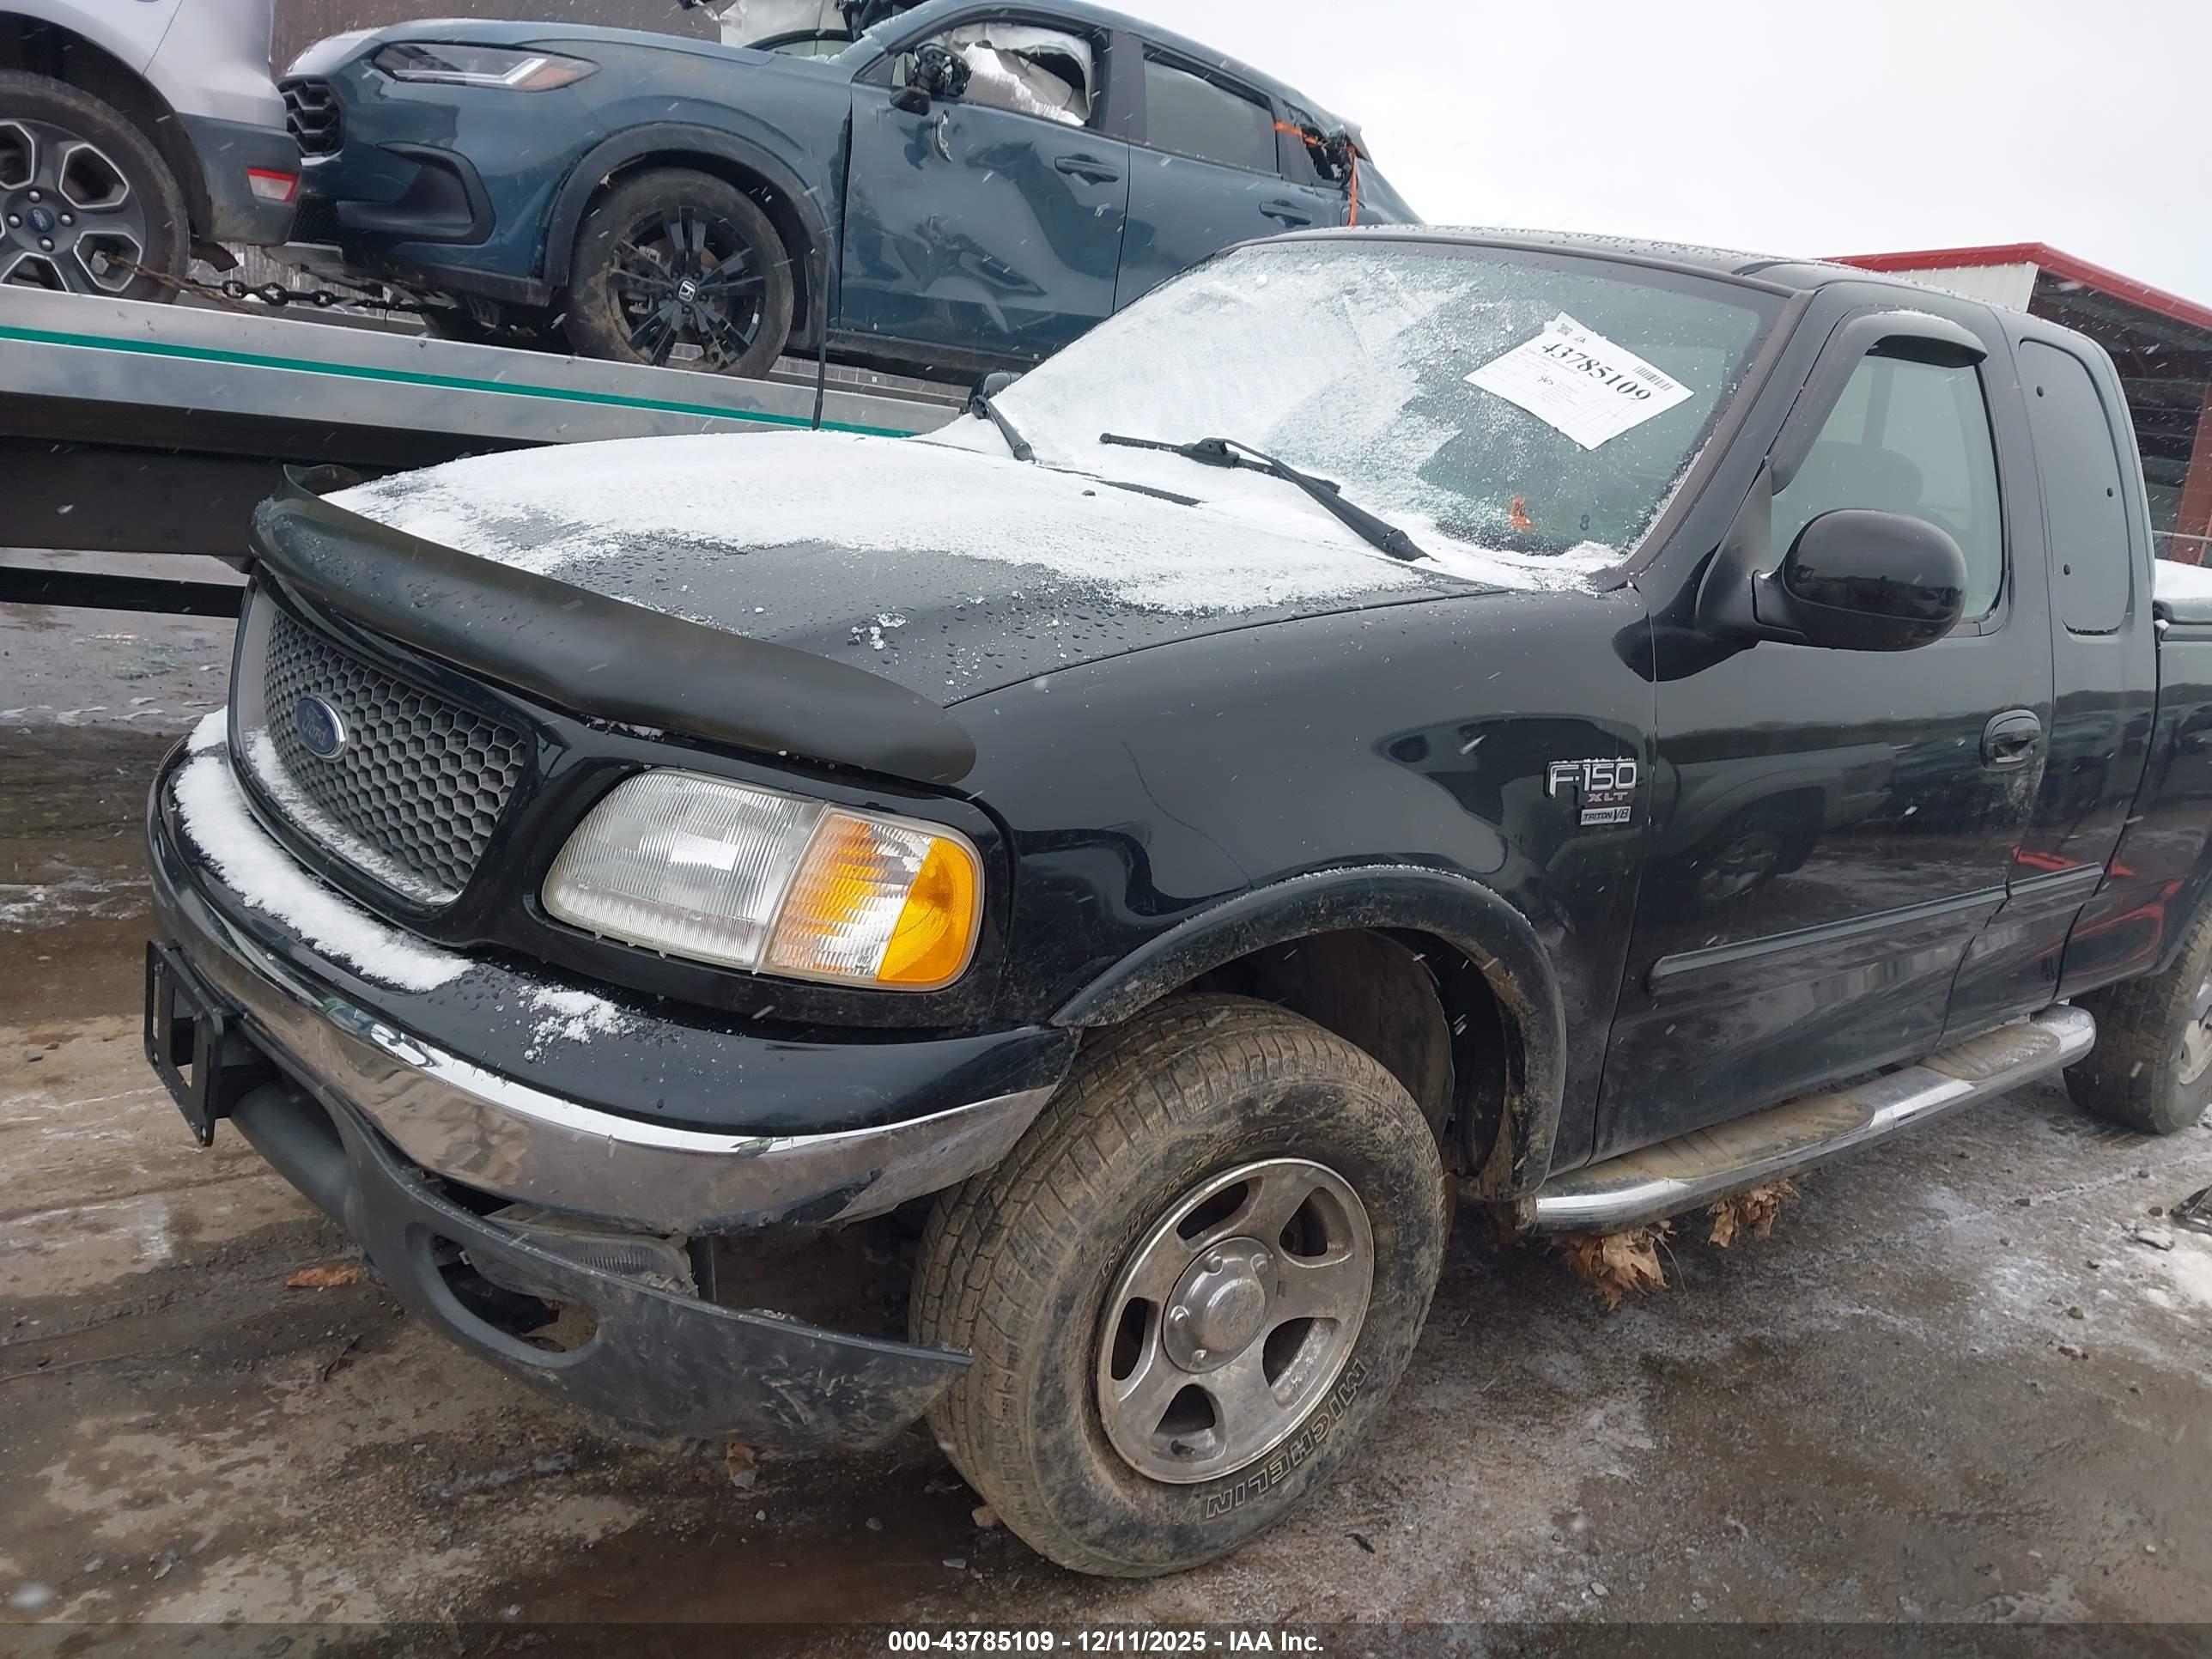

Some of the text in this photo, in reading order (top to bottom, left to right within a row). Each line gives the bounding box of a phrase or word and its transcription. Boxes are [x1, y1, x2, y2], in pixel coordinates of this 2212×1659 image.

[1541, 343, 1651, 400] 43785109
[1549, 761, 1637, 799] F-150
[1587, 791, 1629, 803] XLT
[1583, 807, 1630, 822] TRITON V8
[1205, 1358, 1368, 1520] MICHELIN
